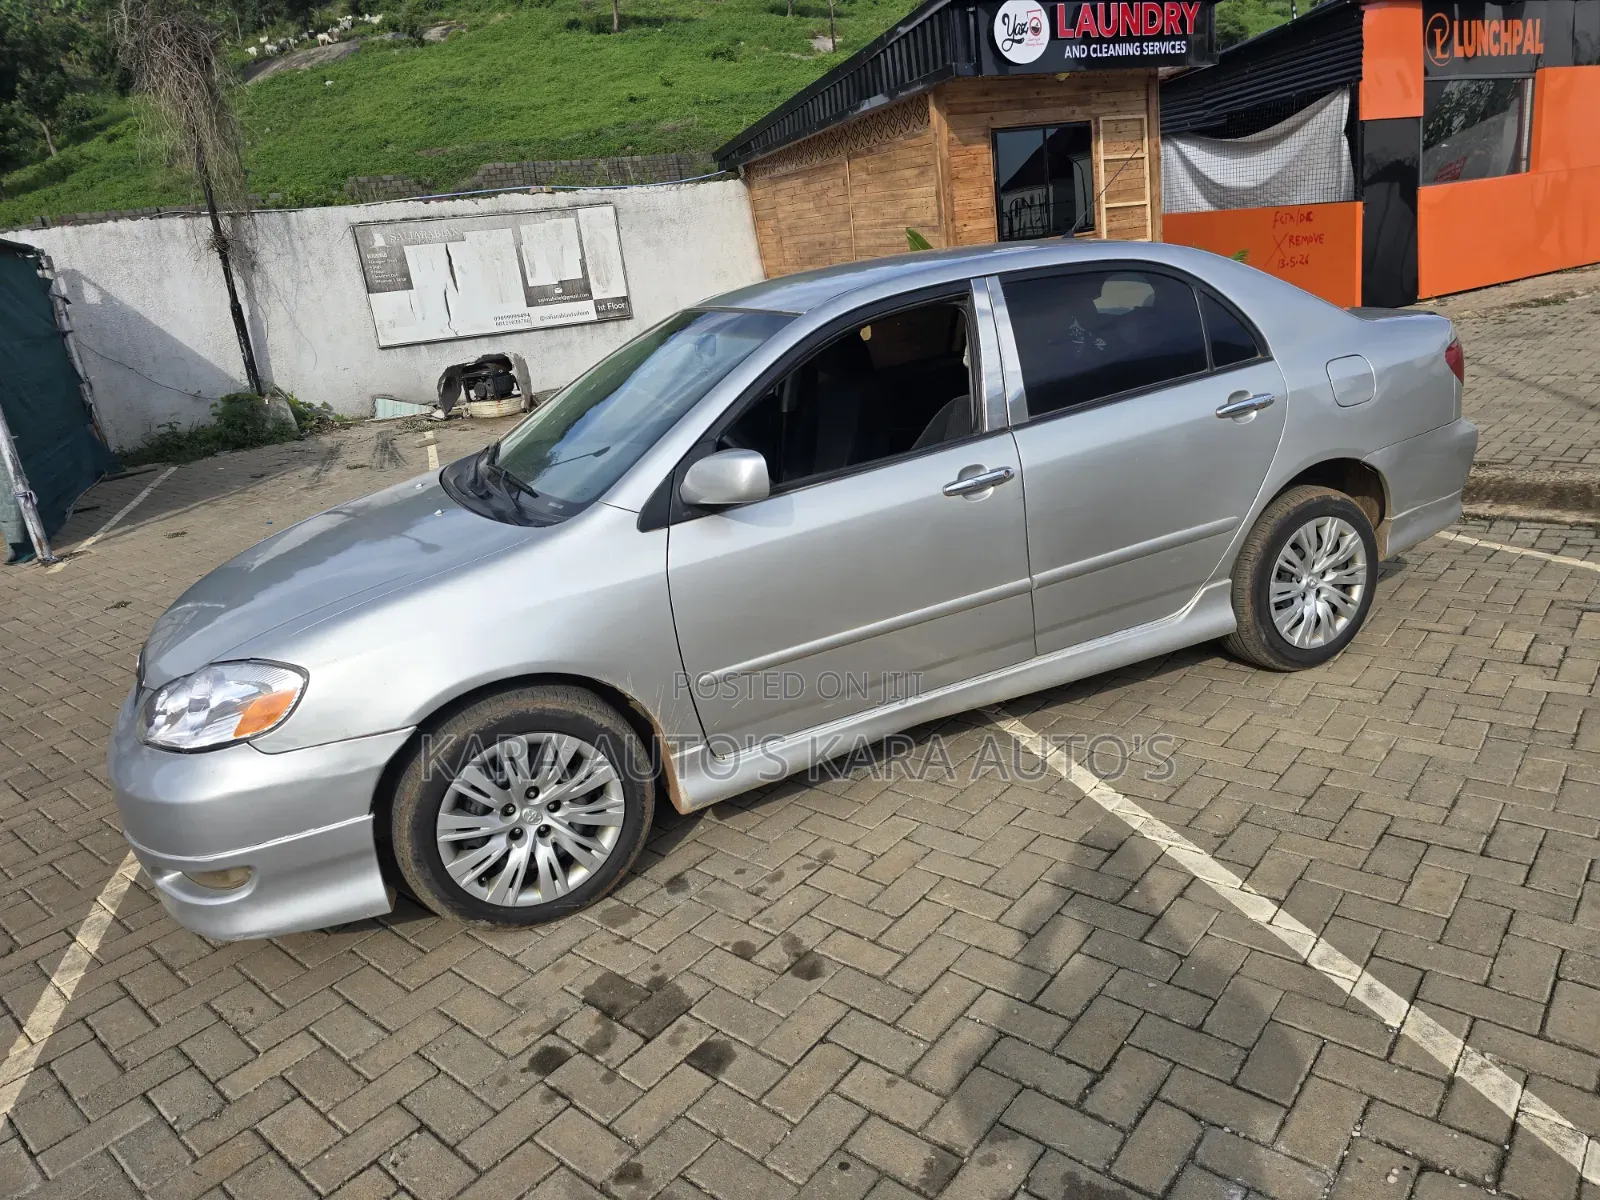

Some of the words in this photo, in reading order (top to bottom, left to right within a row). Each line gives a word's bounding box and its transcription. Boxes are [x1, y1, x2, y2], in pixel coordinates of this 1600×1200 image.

[1056, 1, 1201, 39] LAUNDRY
[1453, 18, 1544, 58] LUNCHPAL
[1064, 44, 1088, 59] AND
[1090, 42, 1141, 58] CLEANING
[1142, 40, 1187, 55] SERVICES
[1288, 232, 1325, 248] REMOVE
[597, 304, 606, 312] 1st
[606, 302, 626, 311] Floor
